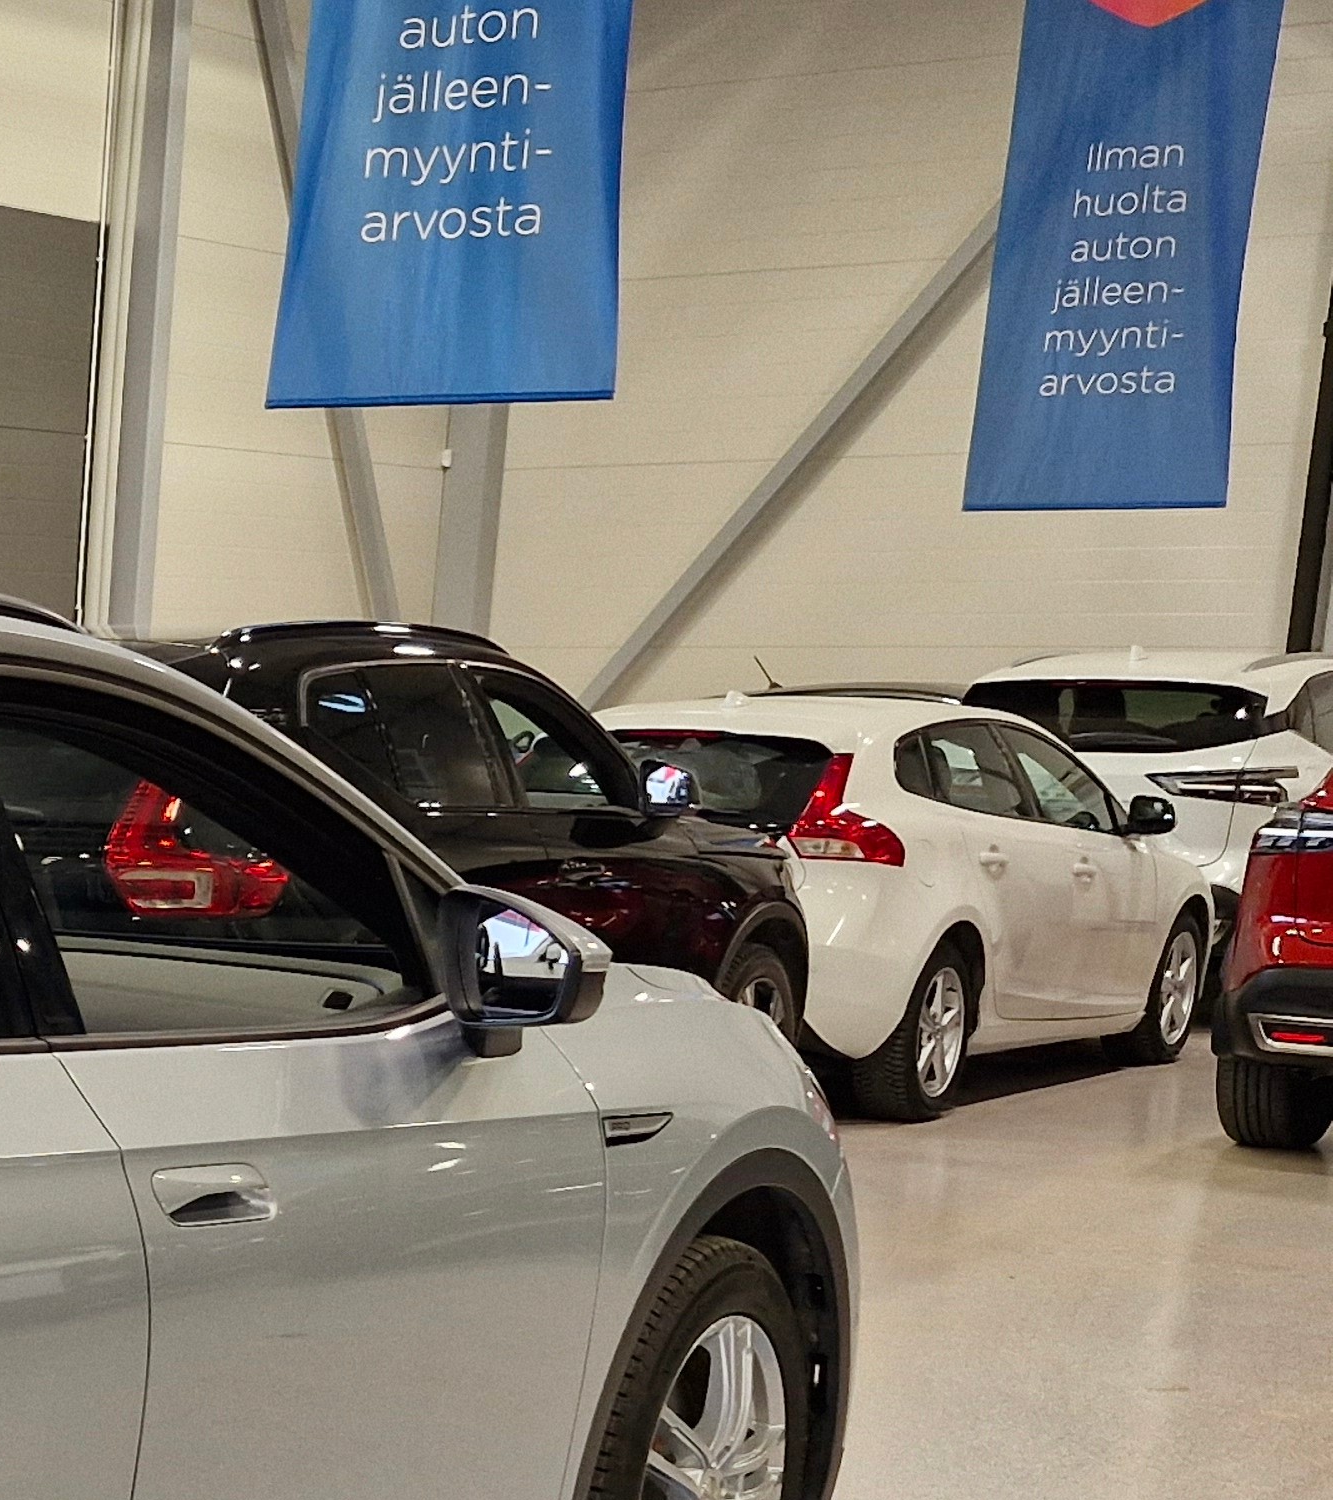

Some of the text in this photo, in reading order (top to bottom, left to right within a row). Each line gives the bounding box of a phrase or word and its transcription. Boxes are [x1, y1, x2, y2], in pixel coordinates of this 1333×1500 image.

[399, 5, 539, 49] auton
[372, 70, 553, 123] jälleen-
[364, 128, 553, 186] myynti-
[1086, 142, 1185, 173] Ilman
[360, 197, 542, 243] arvosta
[1073, 186, 1187, 218] huolta
[1070, 232, 1176, 263] auton
[1050, 277, 1185, 315] jälleen-
[1042, 320, 1185, 357] myynti-
[1038, 366, 1176, 397] arvosta
